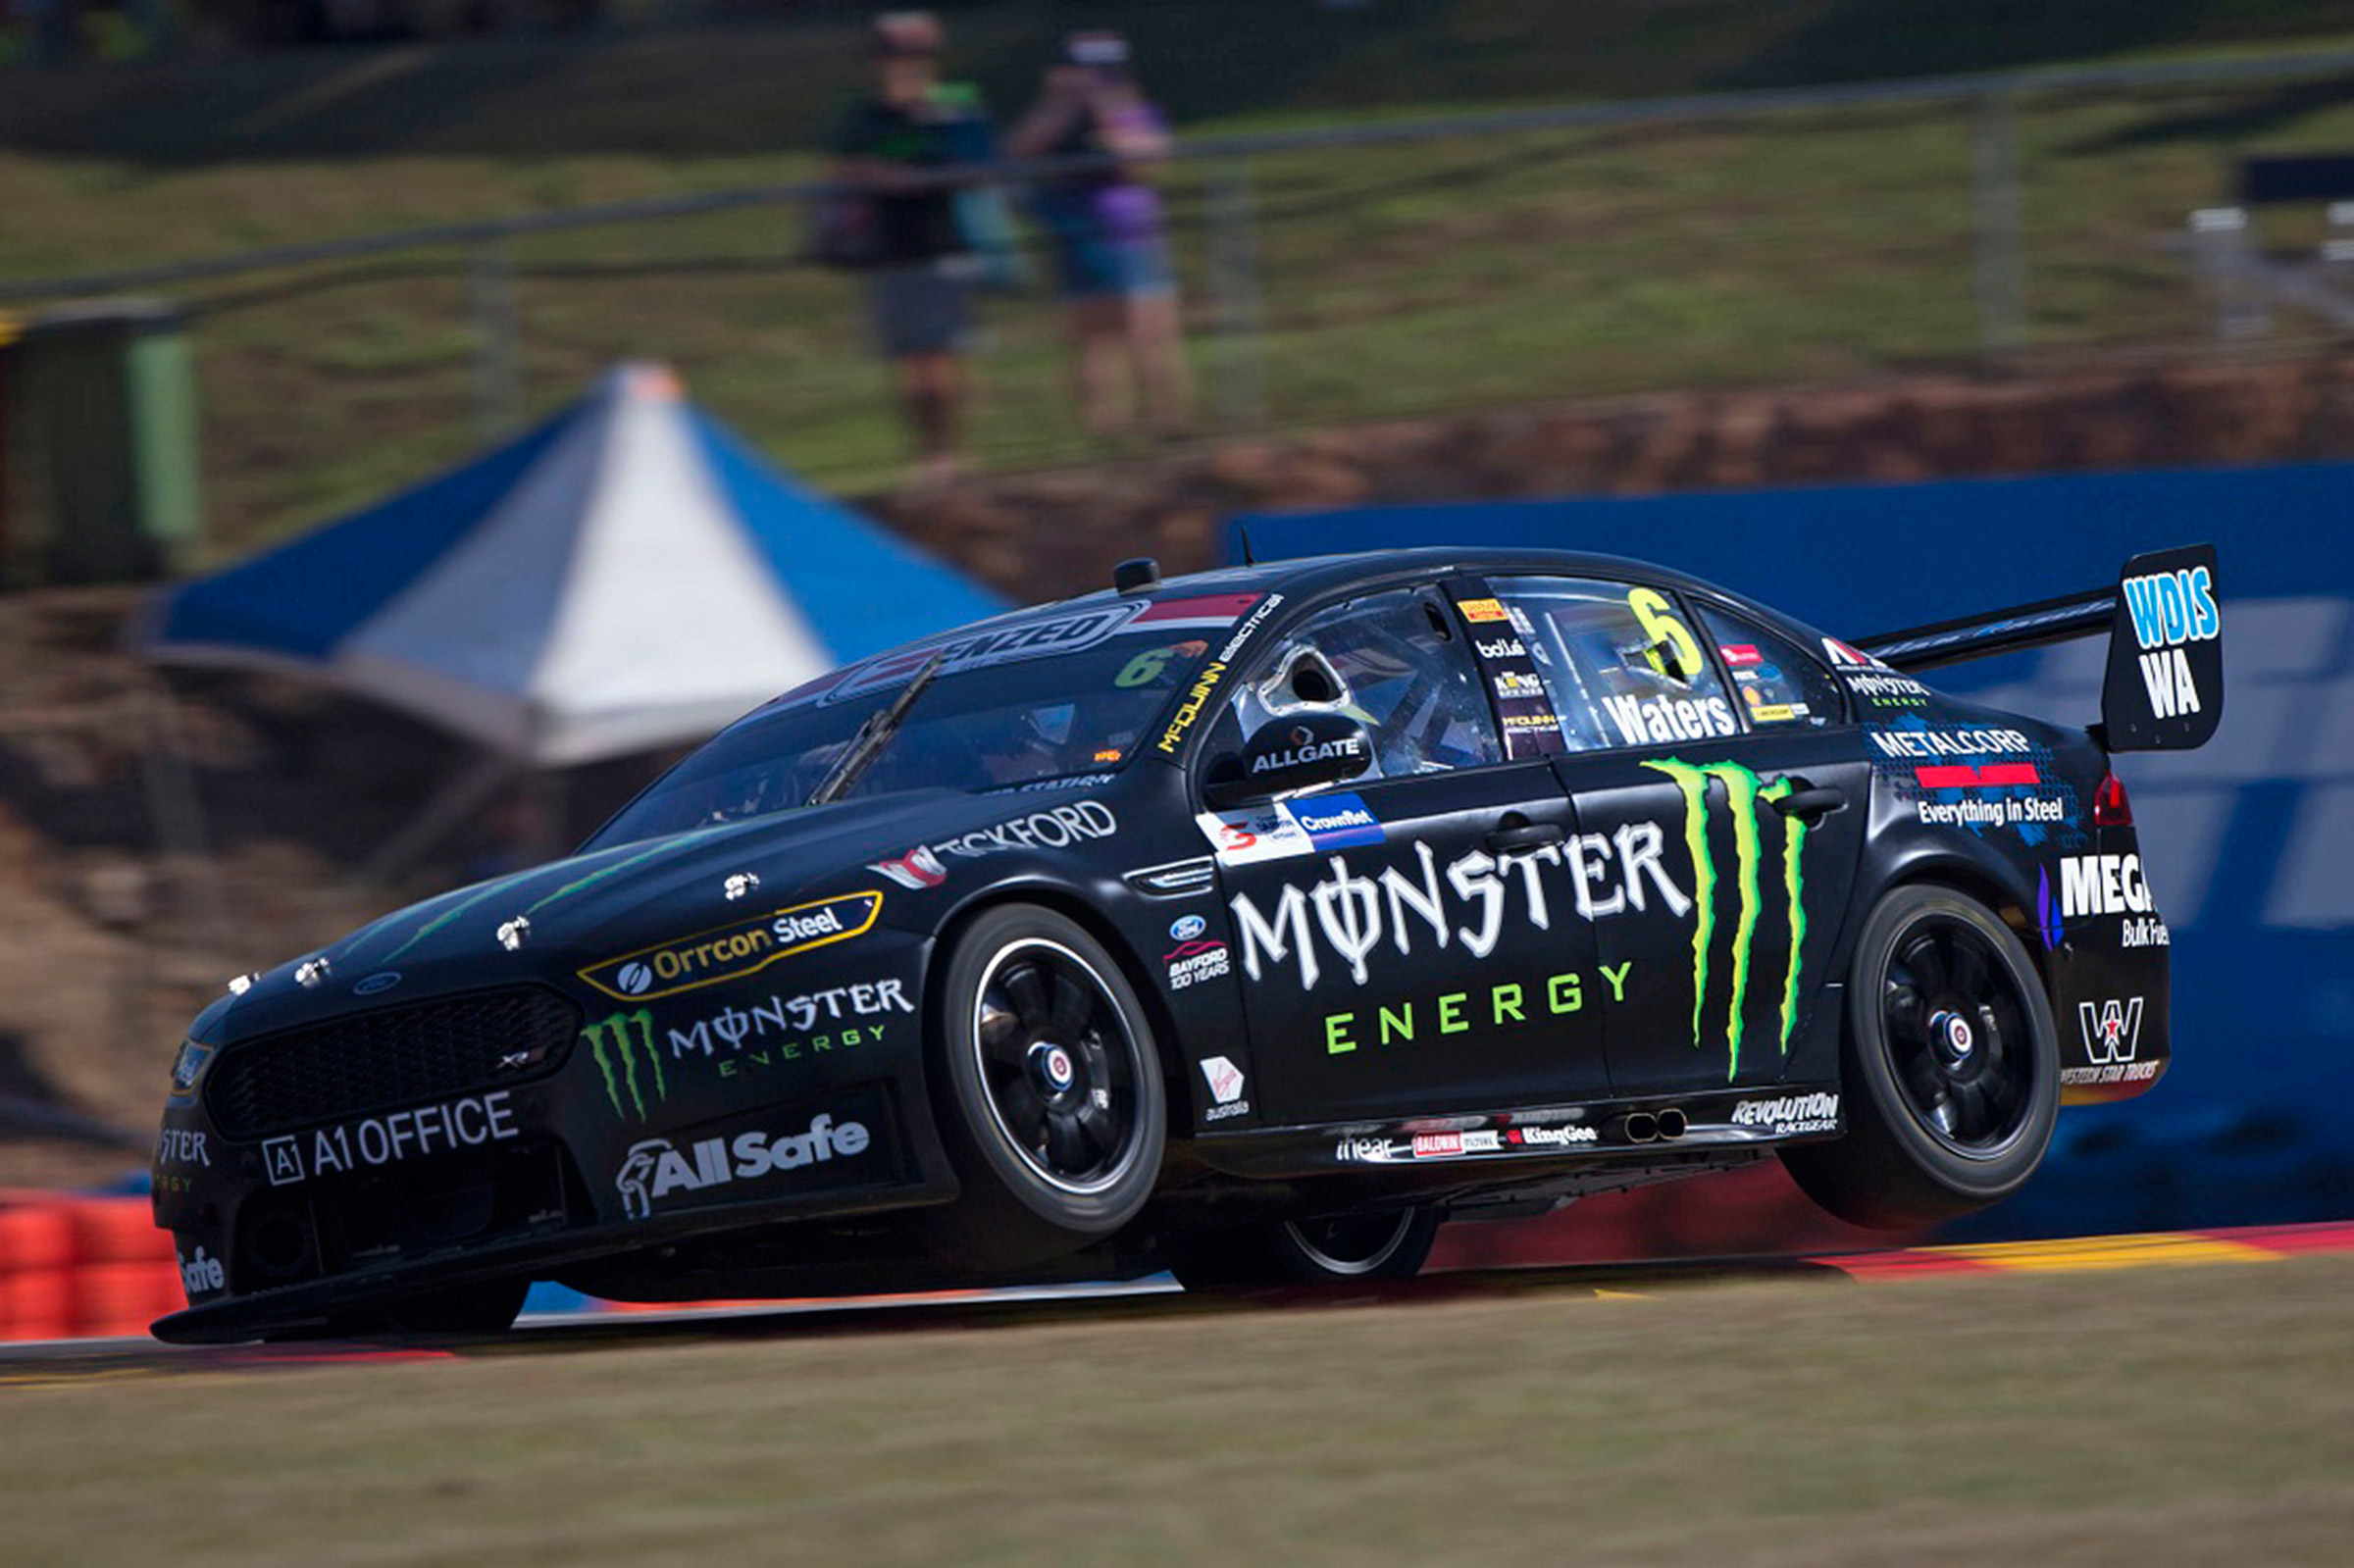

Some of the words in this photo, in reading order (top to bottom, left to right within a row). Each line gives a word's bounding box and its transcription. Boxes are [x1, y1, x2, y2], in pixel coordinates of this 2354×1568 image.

[1628, 588, 1703, 676] 6
[2123, 566, 2220, 649] WDIS
[1114, 648, 1176, 687] 6
[2139, 648, 2200, 719] WA
[1603, 695, 1735, 744] Waters
[1871, 730, 2030, 758] METALCORP
[1252, 738, 1359, 774] ALLGATE
[1918, 798, 2004, 827] Everything
[2006, 797, 2023, 822] in
[2024, 796, 2064, 822] Steel
[1229, 821, 1691, 990] MONSTER
[653, 929, 773, 979] Orrcon
[773, 907, 844, 944] Steel
[1169, 947, 1228, 978] BAYFORD
[667, 979, 915, 1059] MONSTER
[1325, 962, 1632, 1055] ENERGY
[719, 1025, 886, 1078] ENERGY
[359, 1090, 519, 1166] OFFICE
[1731, 1092, 1839, 1126] REVOLUTION
[159, 1130, 211, 1168] STER
